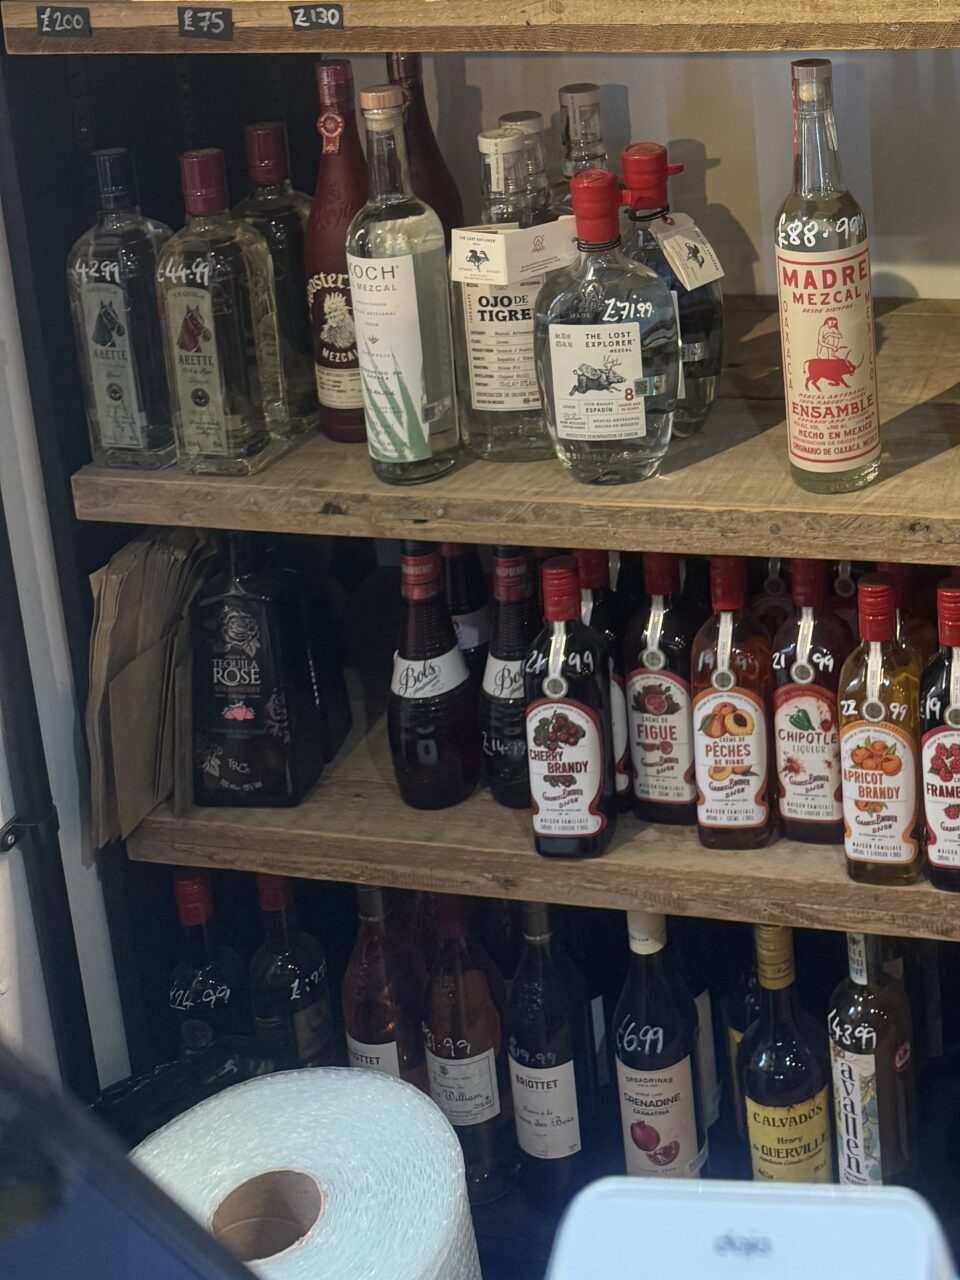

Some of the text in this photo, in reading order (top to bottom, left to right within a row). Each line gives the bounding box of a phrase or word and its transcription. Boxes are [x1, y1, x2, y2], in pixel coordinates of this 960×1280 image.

[39, 10, 85, 32] £200
[183, 9, 225, 32] £75
[294, 7, 340, 26] £130
[782, 259, 868, 291] MADRE
[357, 284, 398, 292] MEZCAL
[478, 295, 529, 308] OJO DE
[792, 286, 861, 306] MEZCAL
[478, 308, 532, 323] TIGRE
[585, 340, 632, 348] EXPLORER
[178, 355, 214, 367] ARETTE
[624, 388, 634, 401] 8
[792, 394, 874, 419] ENSAMBLE
[212, 659, 258, 670] TEQUILA
[213, 669, 261, 686] ROSE
[637, 726, 677, 740] FIGUE
[778, 729, 838, 745] CHIPOTLE
[529, 748, 564, 763] CHERRY
[706, 741, 751, 757] PÊCHES
[793, 744, 826, 753] LIQUEUR
[547, 761, 588, 774] BRANDY
[843, 770, 884, 785] APRICOT
[858, 785, 901, 800] BRANDY
[515, 1074, 559, 1089] BRIOTTET
[623, 1092, 681, 1108] GRENADINE
[753, 1104, 823, 1129] CALVADOS
